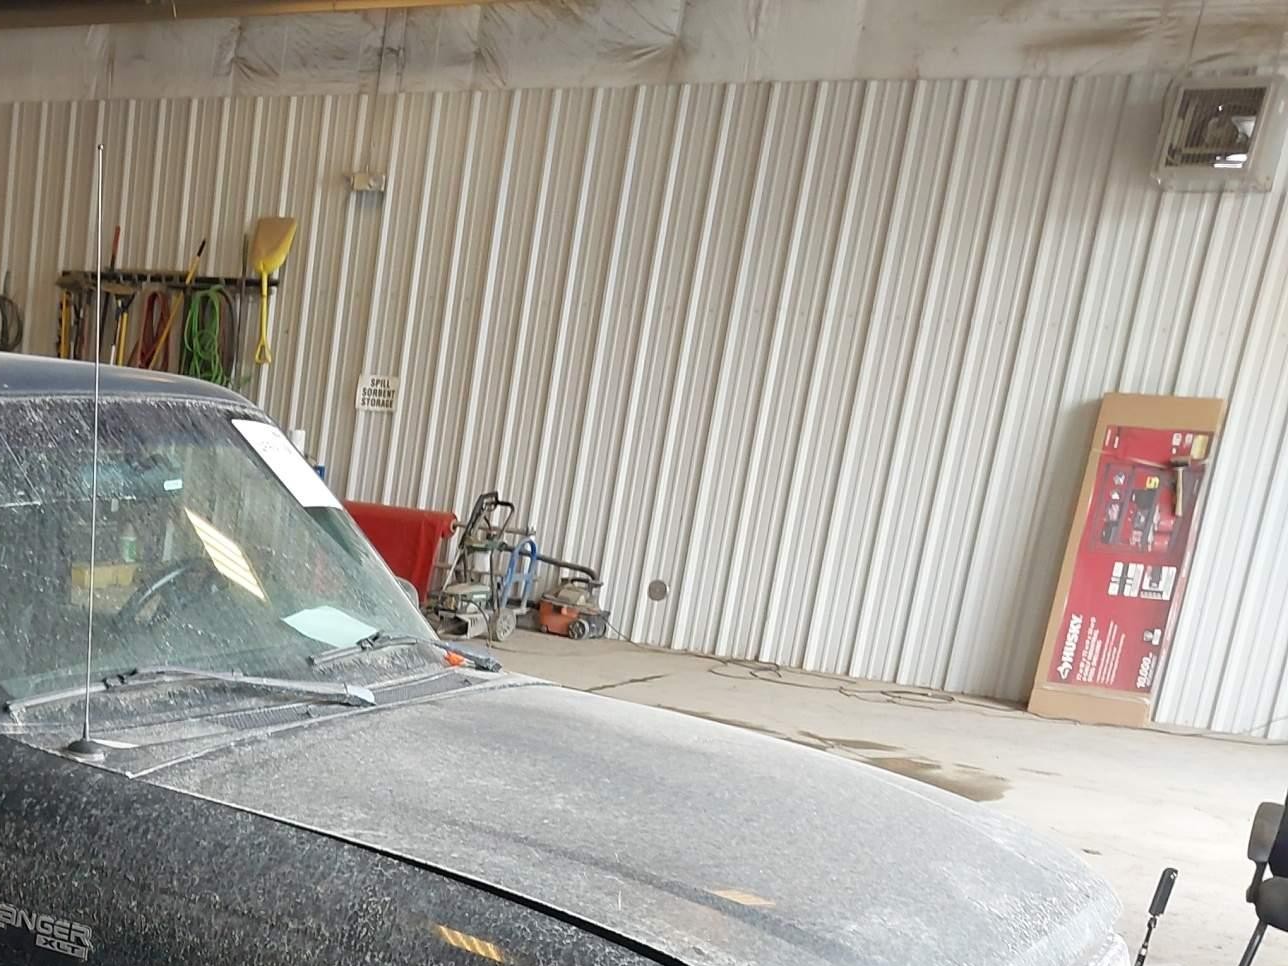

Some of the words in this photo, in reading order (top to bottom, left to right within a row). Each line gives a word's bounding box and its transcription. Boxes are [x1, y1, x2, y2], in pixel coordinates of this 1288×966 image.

[370, 378, 390, 388] SPILL
[361, 387, 395, 399] SORBENT
[361, 398, 393, 409] STORAGE
[1061, 614, 1083, 663] HUSKY
[40, 937, 83, 956] XLT
